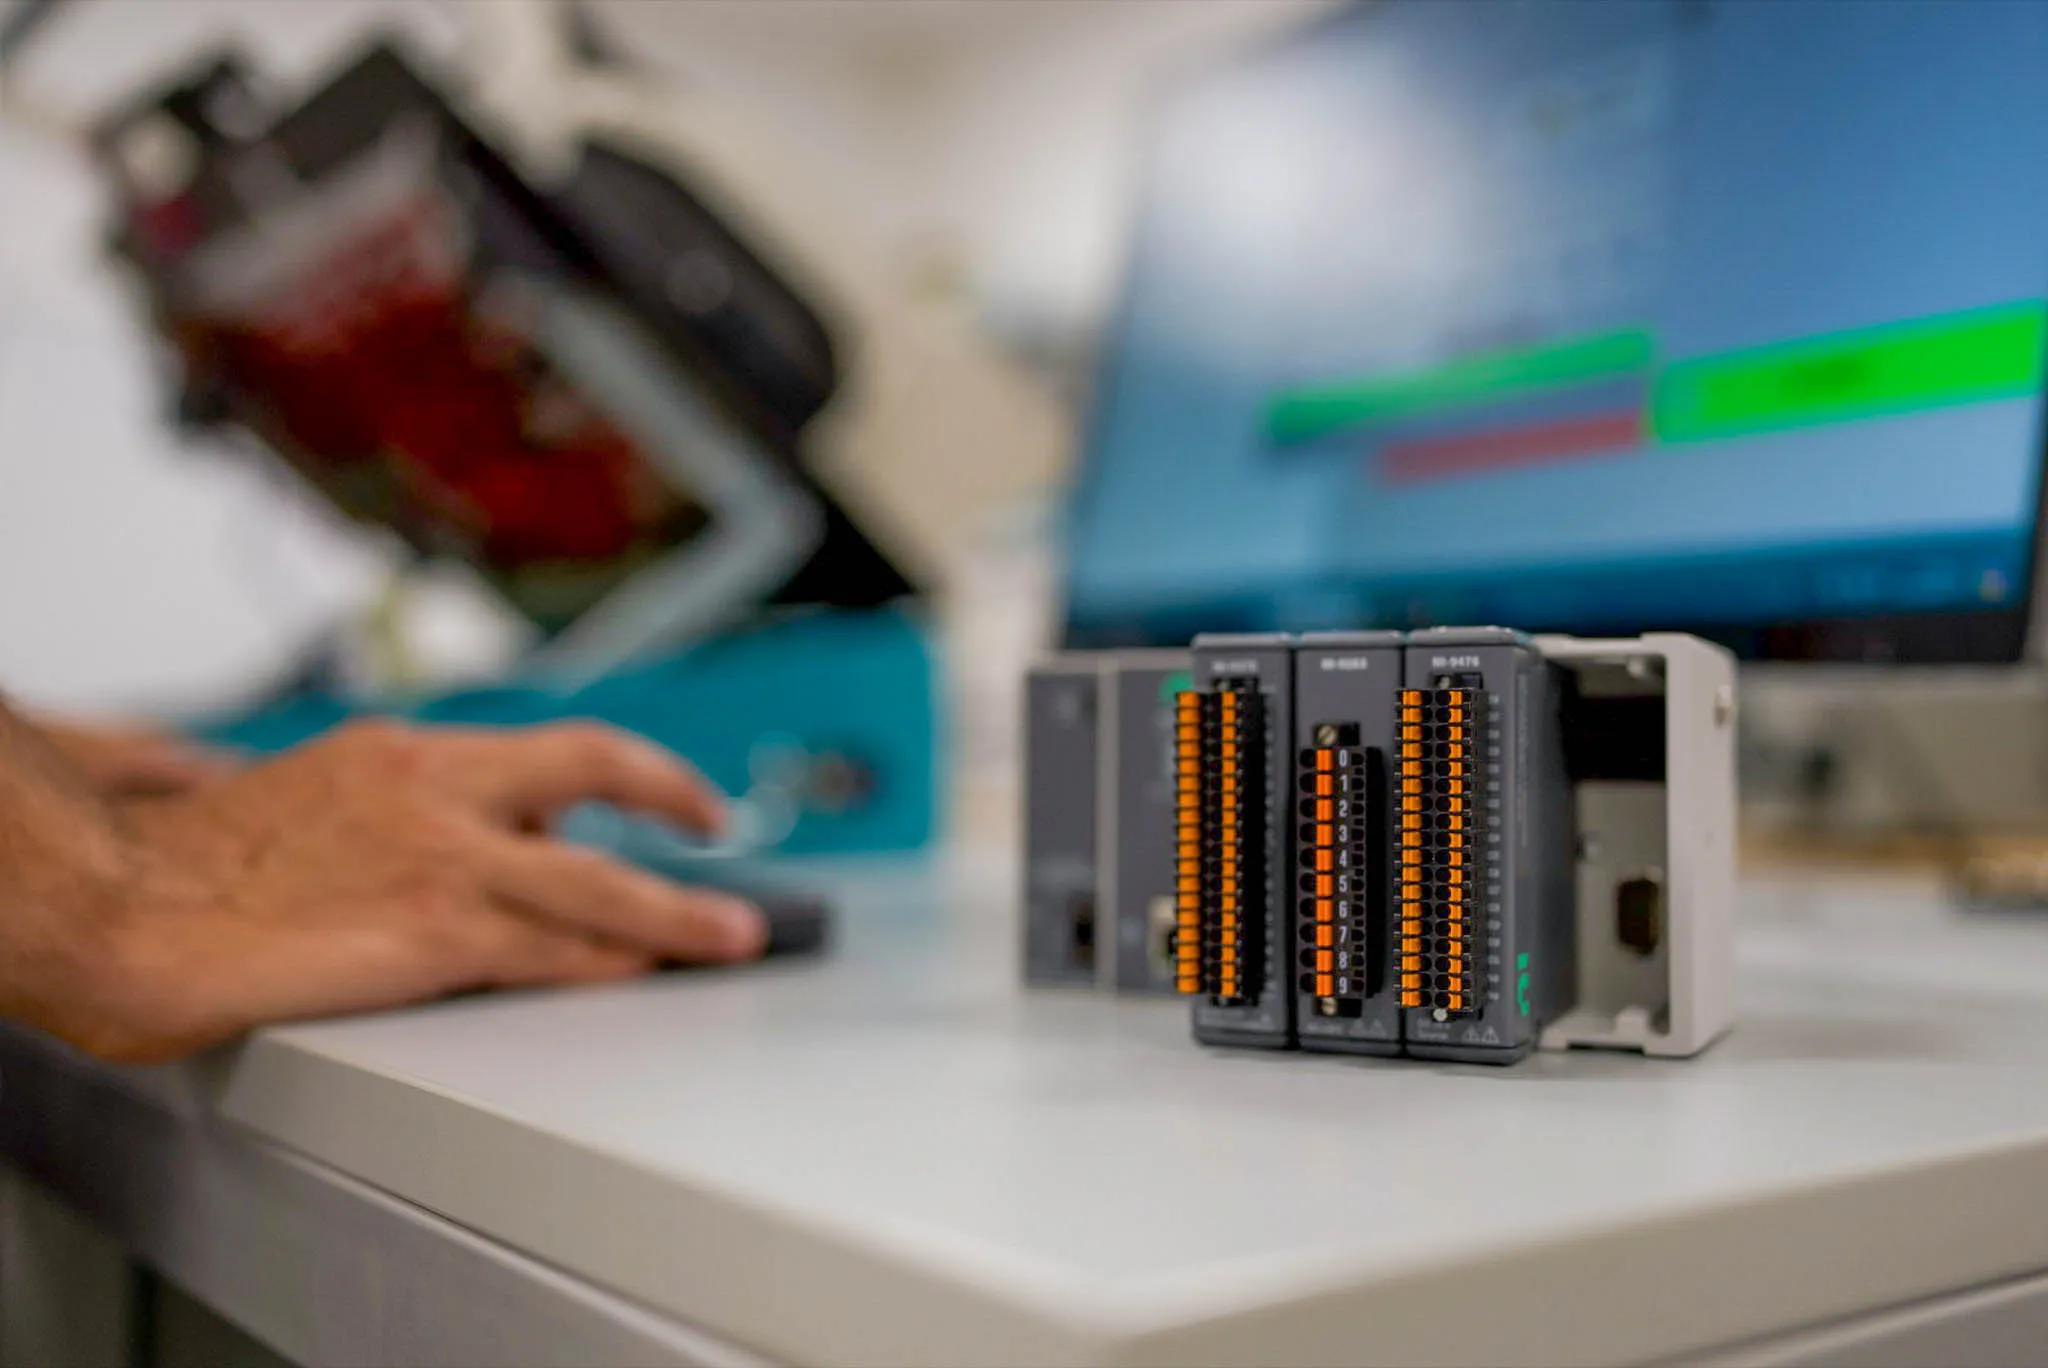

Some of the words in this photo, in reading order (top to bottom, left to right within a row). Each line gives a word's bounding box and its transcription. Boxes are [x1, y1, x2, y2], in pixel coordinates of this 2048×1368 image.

[1339, 749, 1348, 767] 0
[1340, 774, 1348, 792] 1
[1339, 799, 1348, 817] 2
[1339, 824, 1348, 842] 3
[1339, 849, 1348, 867] 4
[1339, 874, 1348, 893] 5
[1339, 900, 1348, 918] 6
[1339, 925, 1348, 943] 7
[1339, 951, 1348, 969] 8
[1339, 976, 1348, 994] 9
